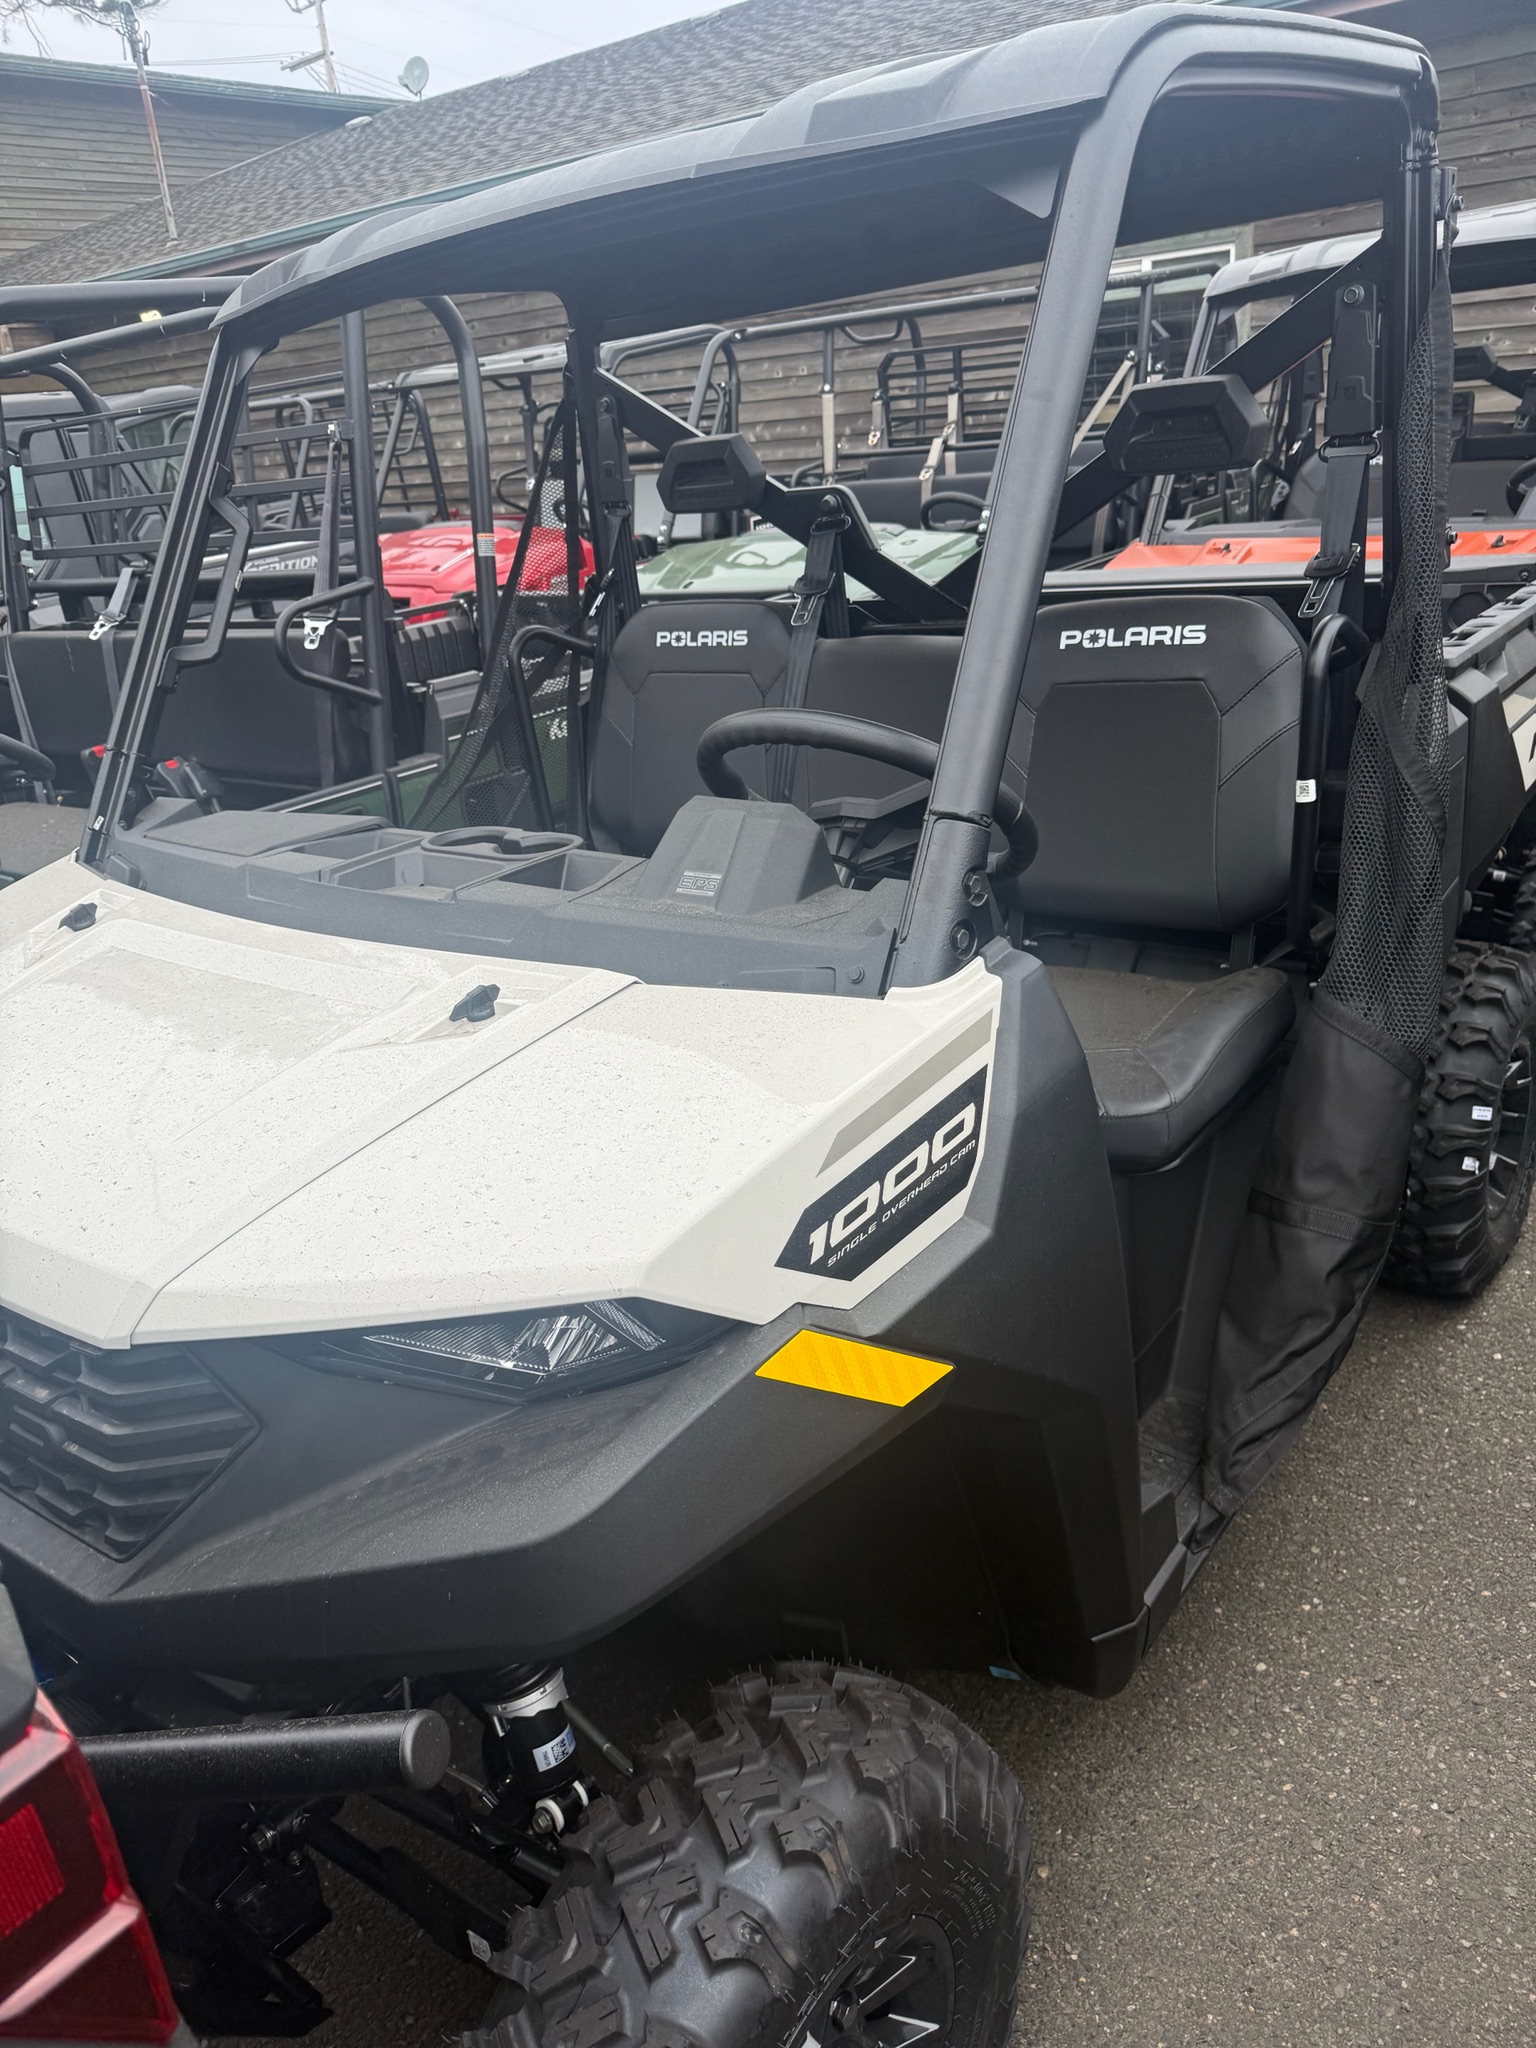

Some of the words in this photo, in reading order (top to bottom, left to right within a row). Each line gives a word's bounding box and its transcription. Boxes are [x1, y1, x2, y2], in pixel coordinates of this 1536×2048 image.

[656, 630, 748, 647] POLARIS
[1059, 624, 1207, 650] POLARIS
[678, 876, 720, 891] EPS
[808, 1102, 976, 1266] 1000
[827, 1221, 877, 1268] SINGLE
[882, 1164, 948, 1223] OVERHEAD
[949, 1139, 976, 1166] CAM
